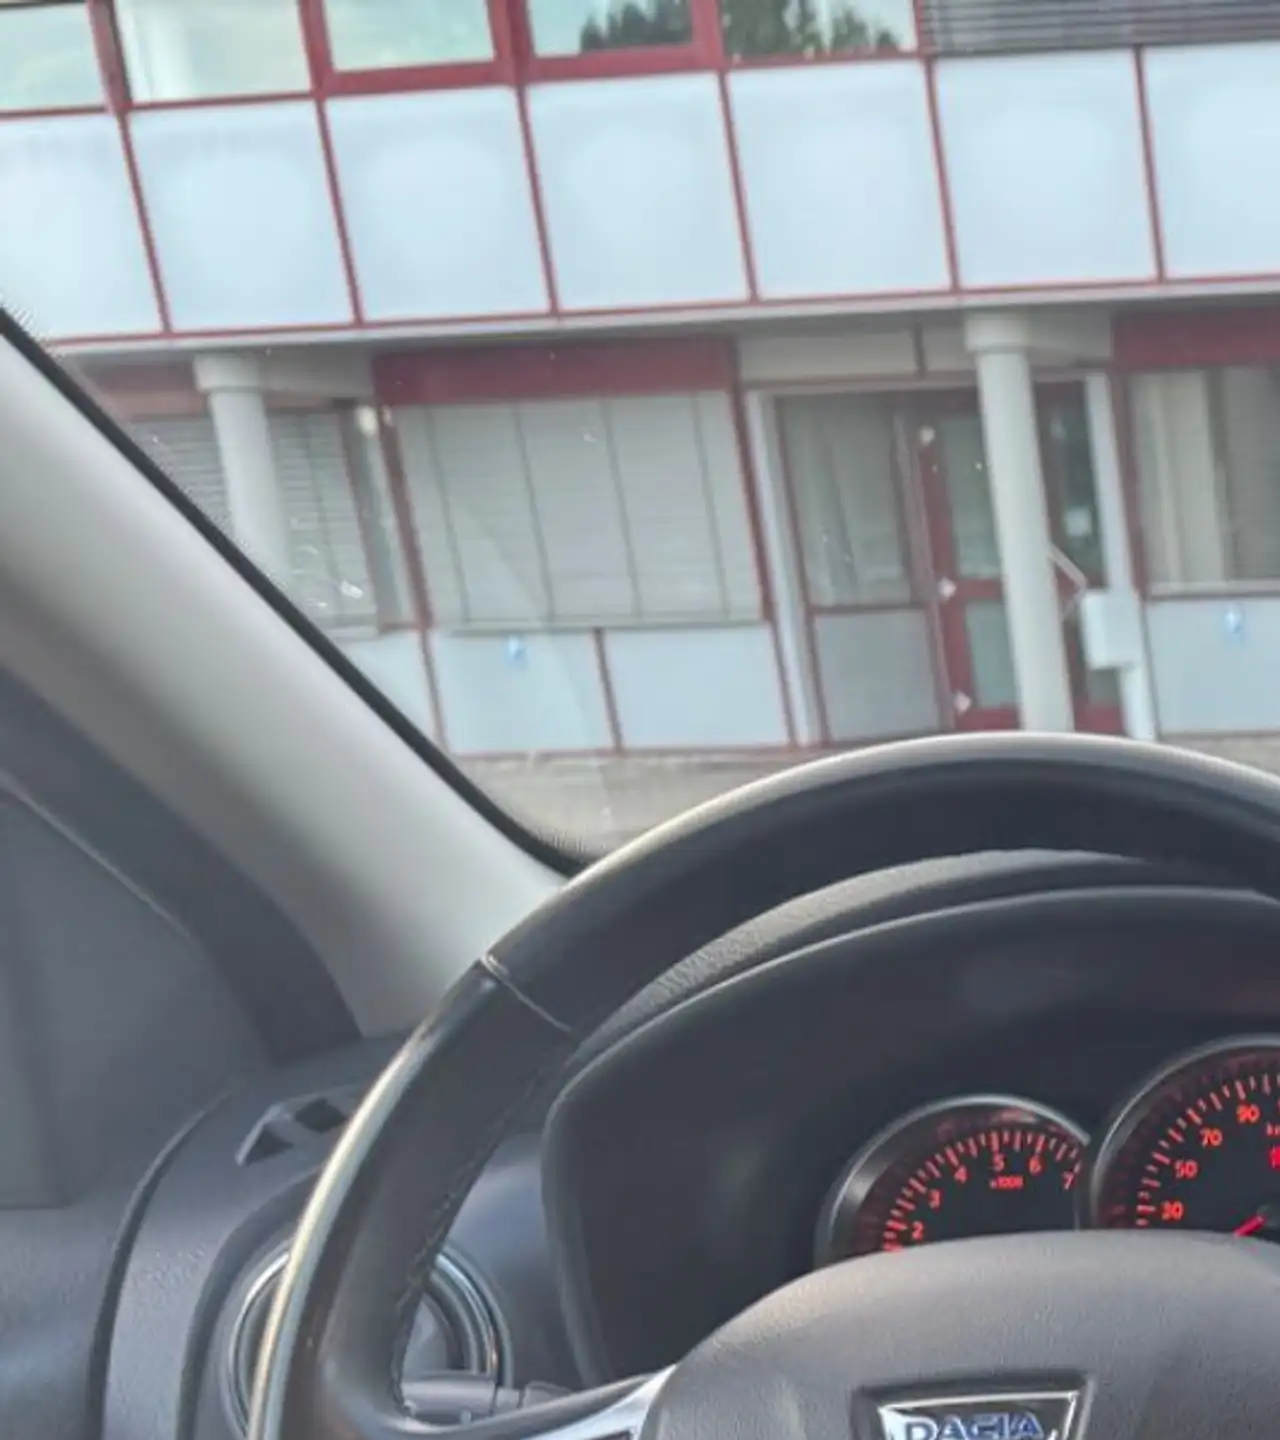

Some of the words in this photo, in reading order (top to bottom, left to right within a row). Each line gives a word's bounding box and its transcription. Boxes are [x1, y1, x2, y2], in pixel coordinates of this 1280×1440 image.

[1236, 1104, 1260, 1123] 90
[1201, 1128, 1223, 1147] 70
[992, 1154, 1005, 1173] 5
[1028, 1157, 1042, 1175] 6
[1174, 1159, 1198, 1179] 50
[954, 1164, 969, 1184] 4
[1062, 1171, 1076, 1190] 7
[1161, 1201, 1184, 1220] 30
[911, 1220, 924, 1240] 2
